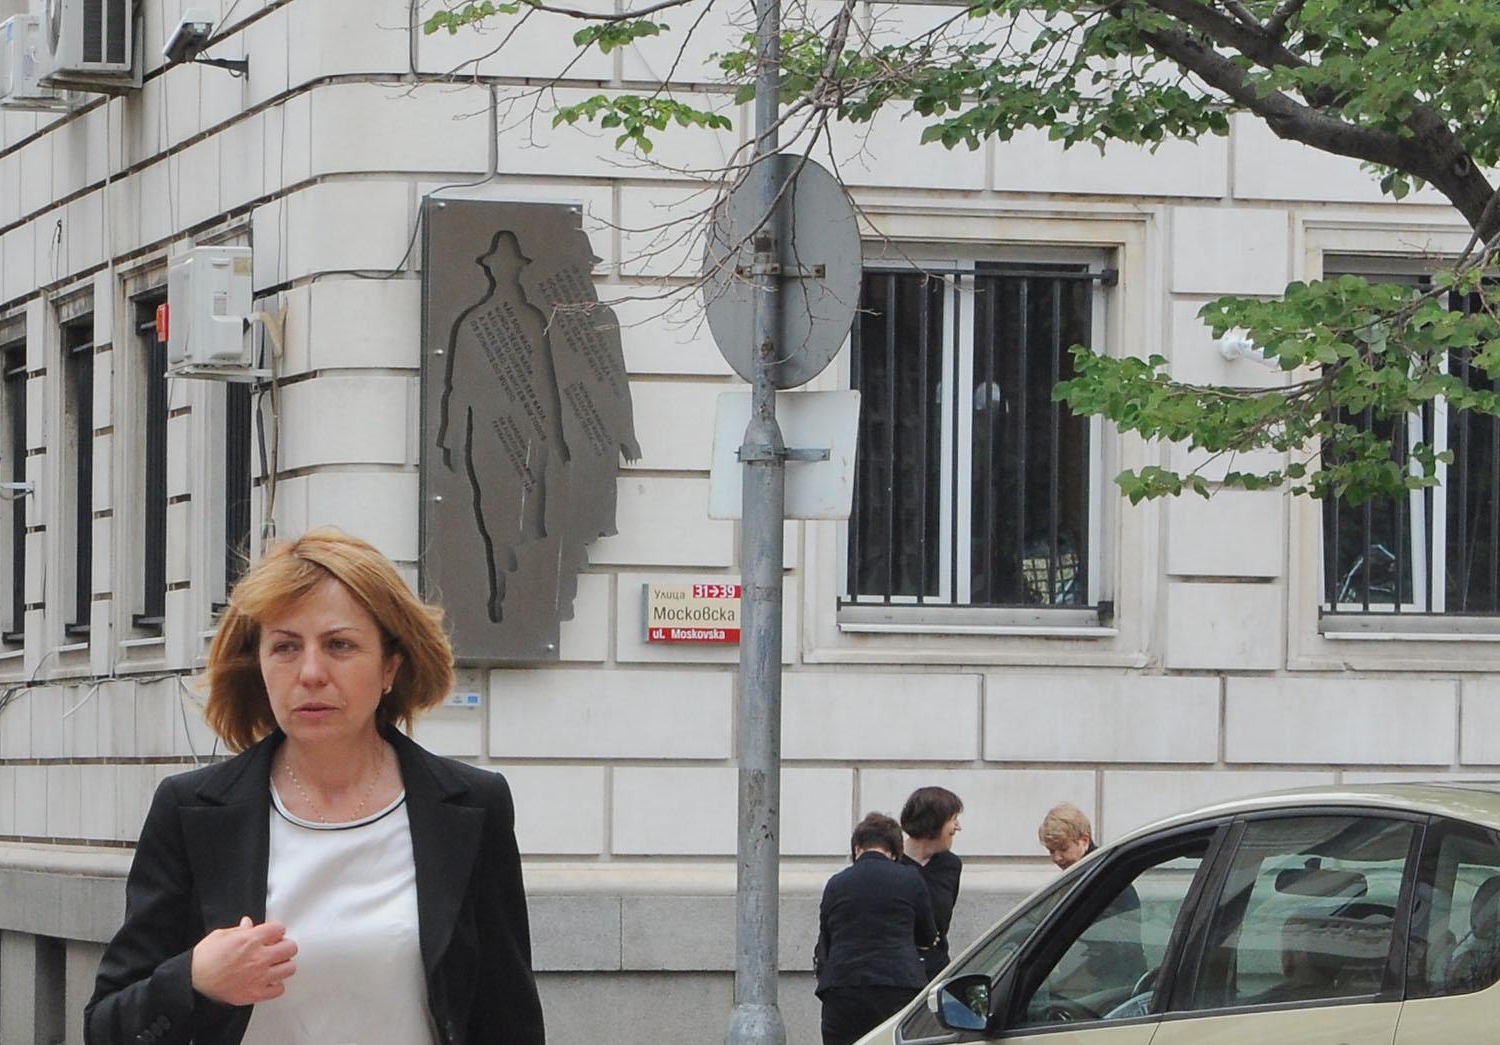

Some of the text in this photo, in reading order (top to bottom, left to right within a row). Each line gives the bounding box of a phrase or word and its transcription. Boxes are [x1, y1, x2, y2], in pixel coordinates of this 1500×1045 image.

[654, 590, 686, 600] Улица
[653, 606, 735, 621] Московска
[671, 629, 726, 639] Moskovska
